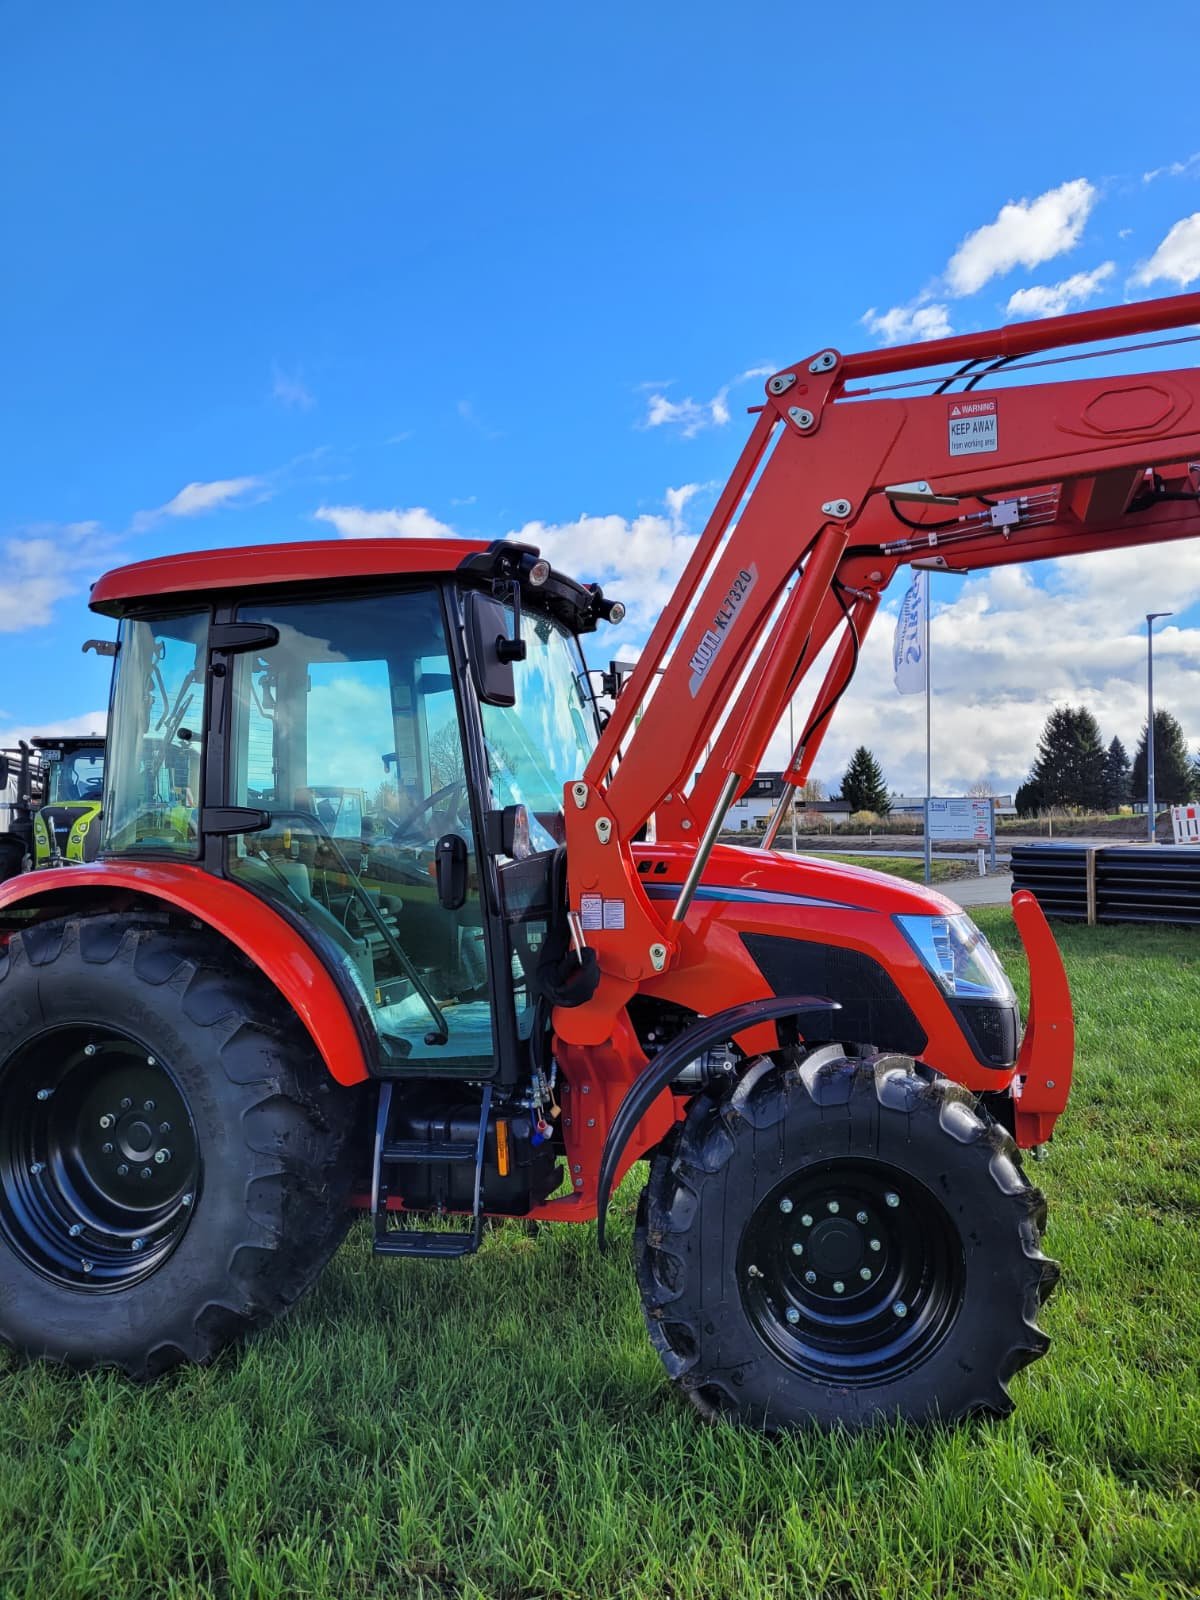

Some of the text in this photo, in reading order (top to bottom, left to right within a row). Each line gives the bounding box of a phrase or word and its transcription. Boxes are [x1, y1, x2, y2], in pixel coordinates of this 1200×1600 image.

[962, 402, 994, 413] WARNING
[952, 420, 994, 436] KEEP AWAY
[952, 439, 995, 449] from working area
[688, 570, 752, 676] KIOTI KL7320
